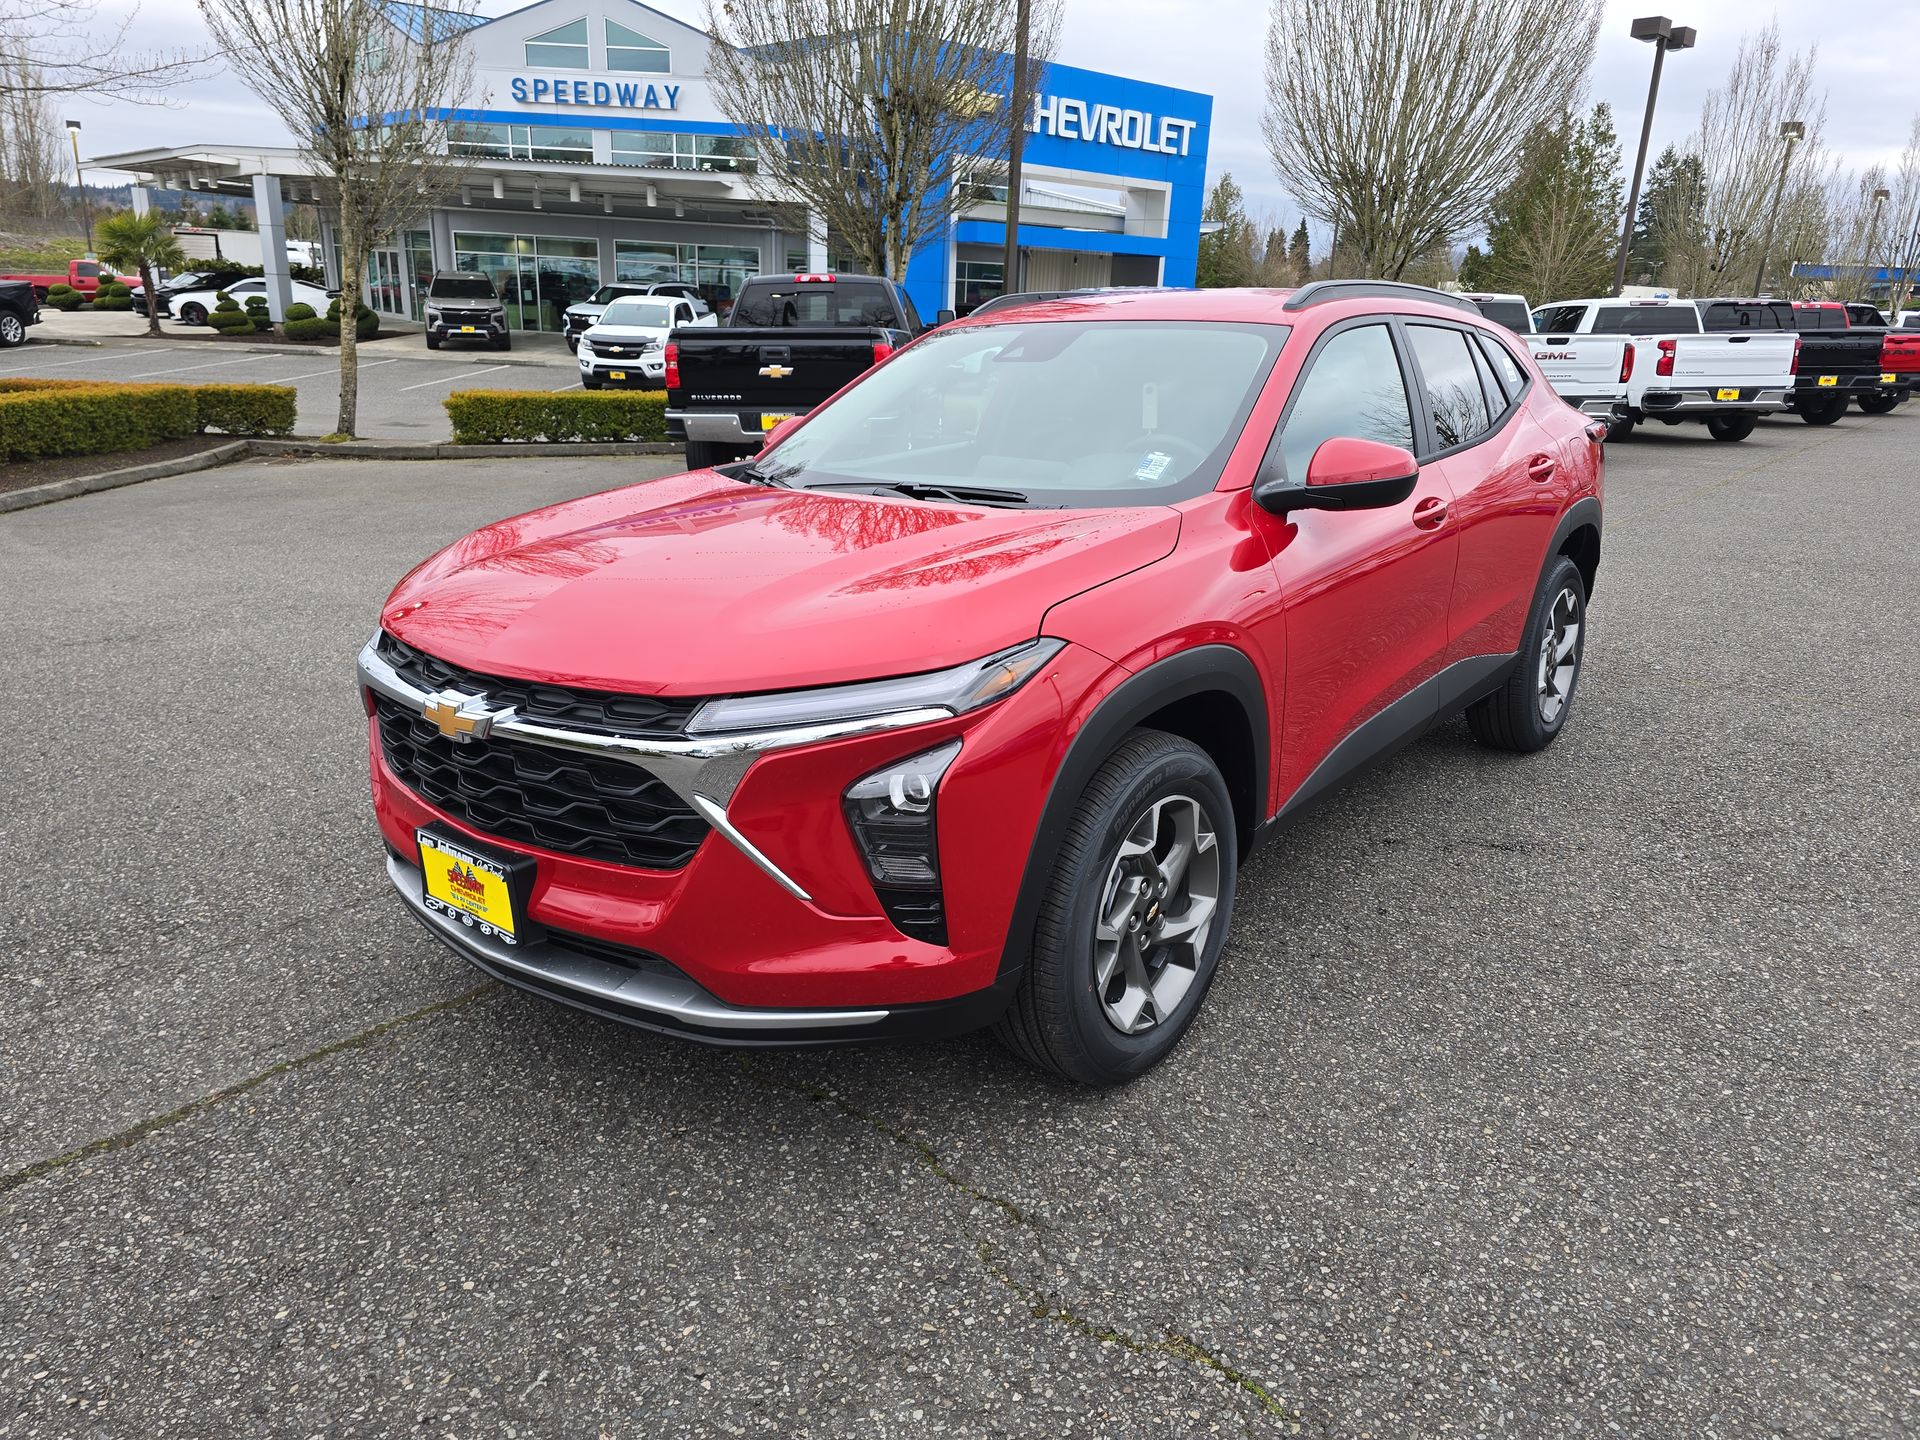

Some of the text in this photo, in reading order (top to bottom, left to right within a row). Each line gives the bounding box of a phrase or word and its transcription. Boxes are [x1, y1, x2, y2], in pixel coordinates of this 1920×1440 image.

[511, 77, 680, 109] SPEEDWAY
[1024, 92, 1197, 156] HEVROLET
[1534, 352, 1577, 360] GMC
